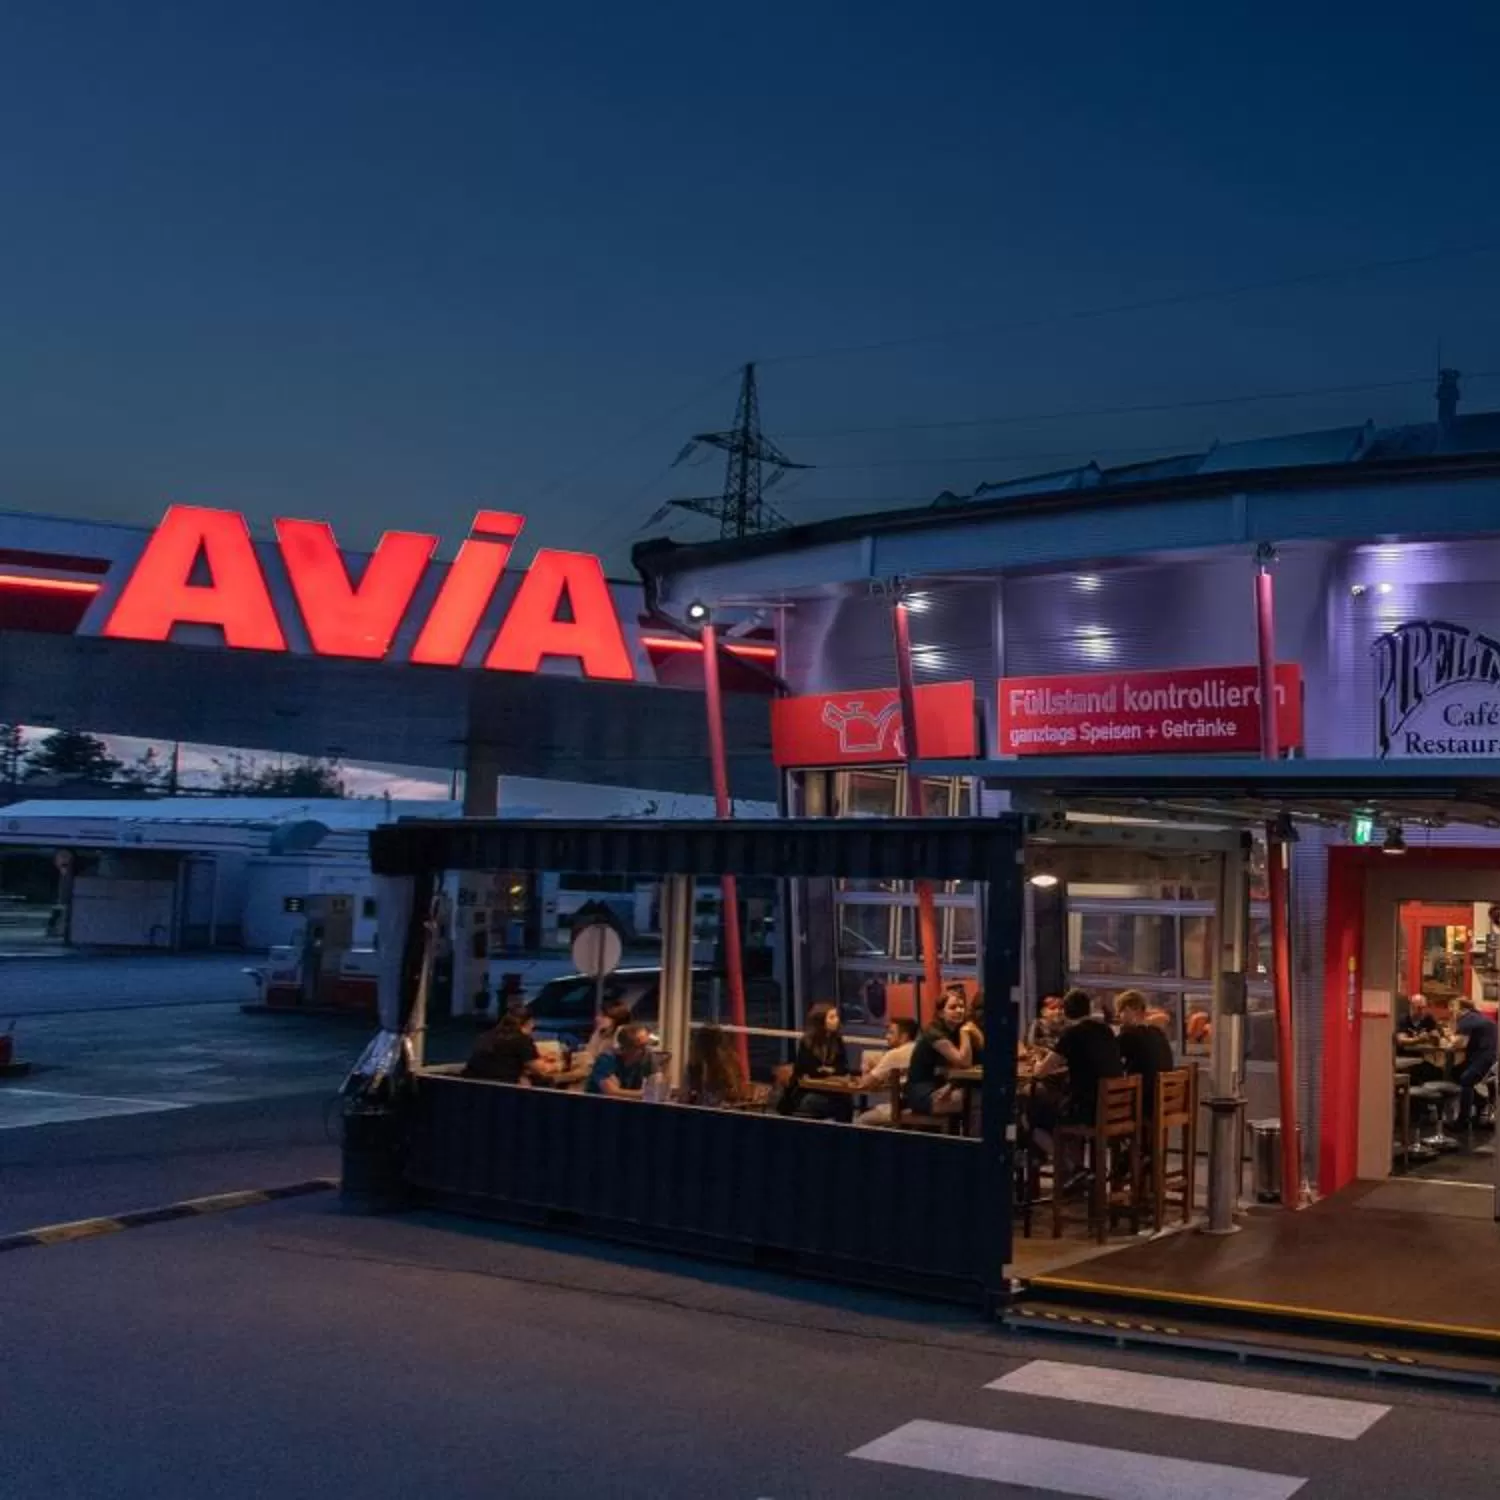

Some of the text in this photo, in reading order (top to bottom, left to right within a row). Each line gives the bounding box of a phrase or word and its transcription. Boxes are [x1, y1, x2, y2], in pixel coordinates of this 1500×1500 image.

[1009, 684, 1117, 716] Füllstand
[1443, 701, 1500, 727] Café
[1010, 716, 1237, 746] ganztags Speisen + Getränke
